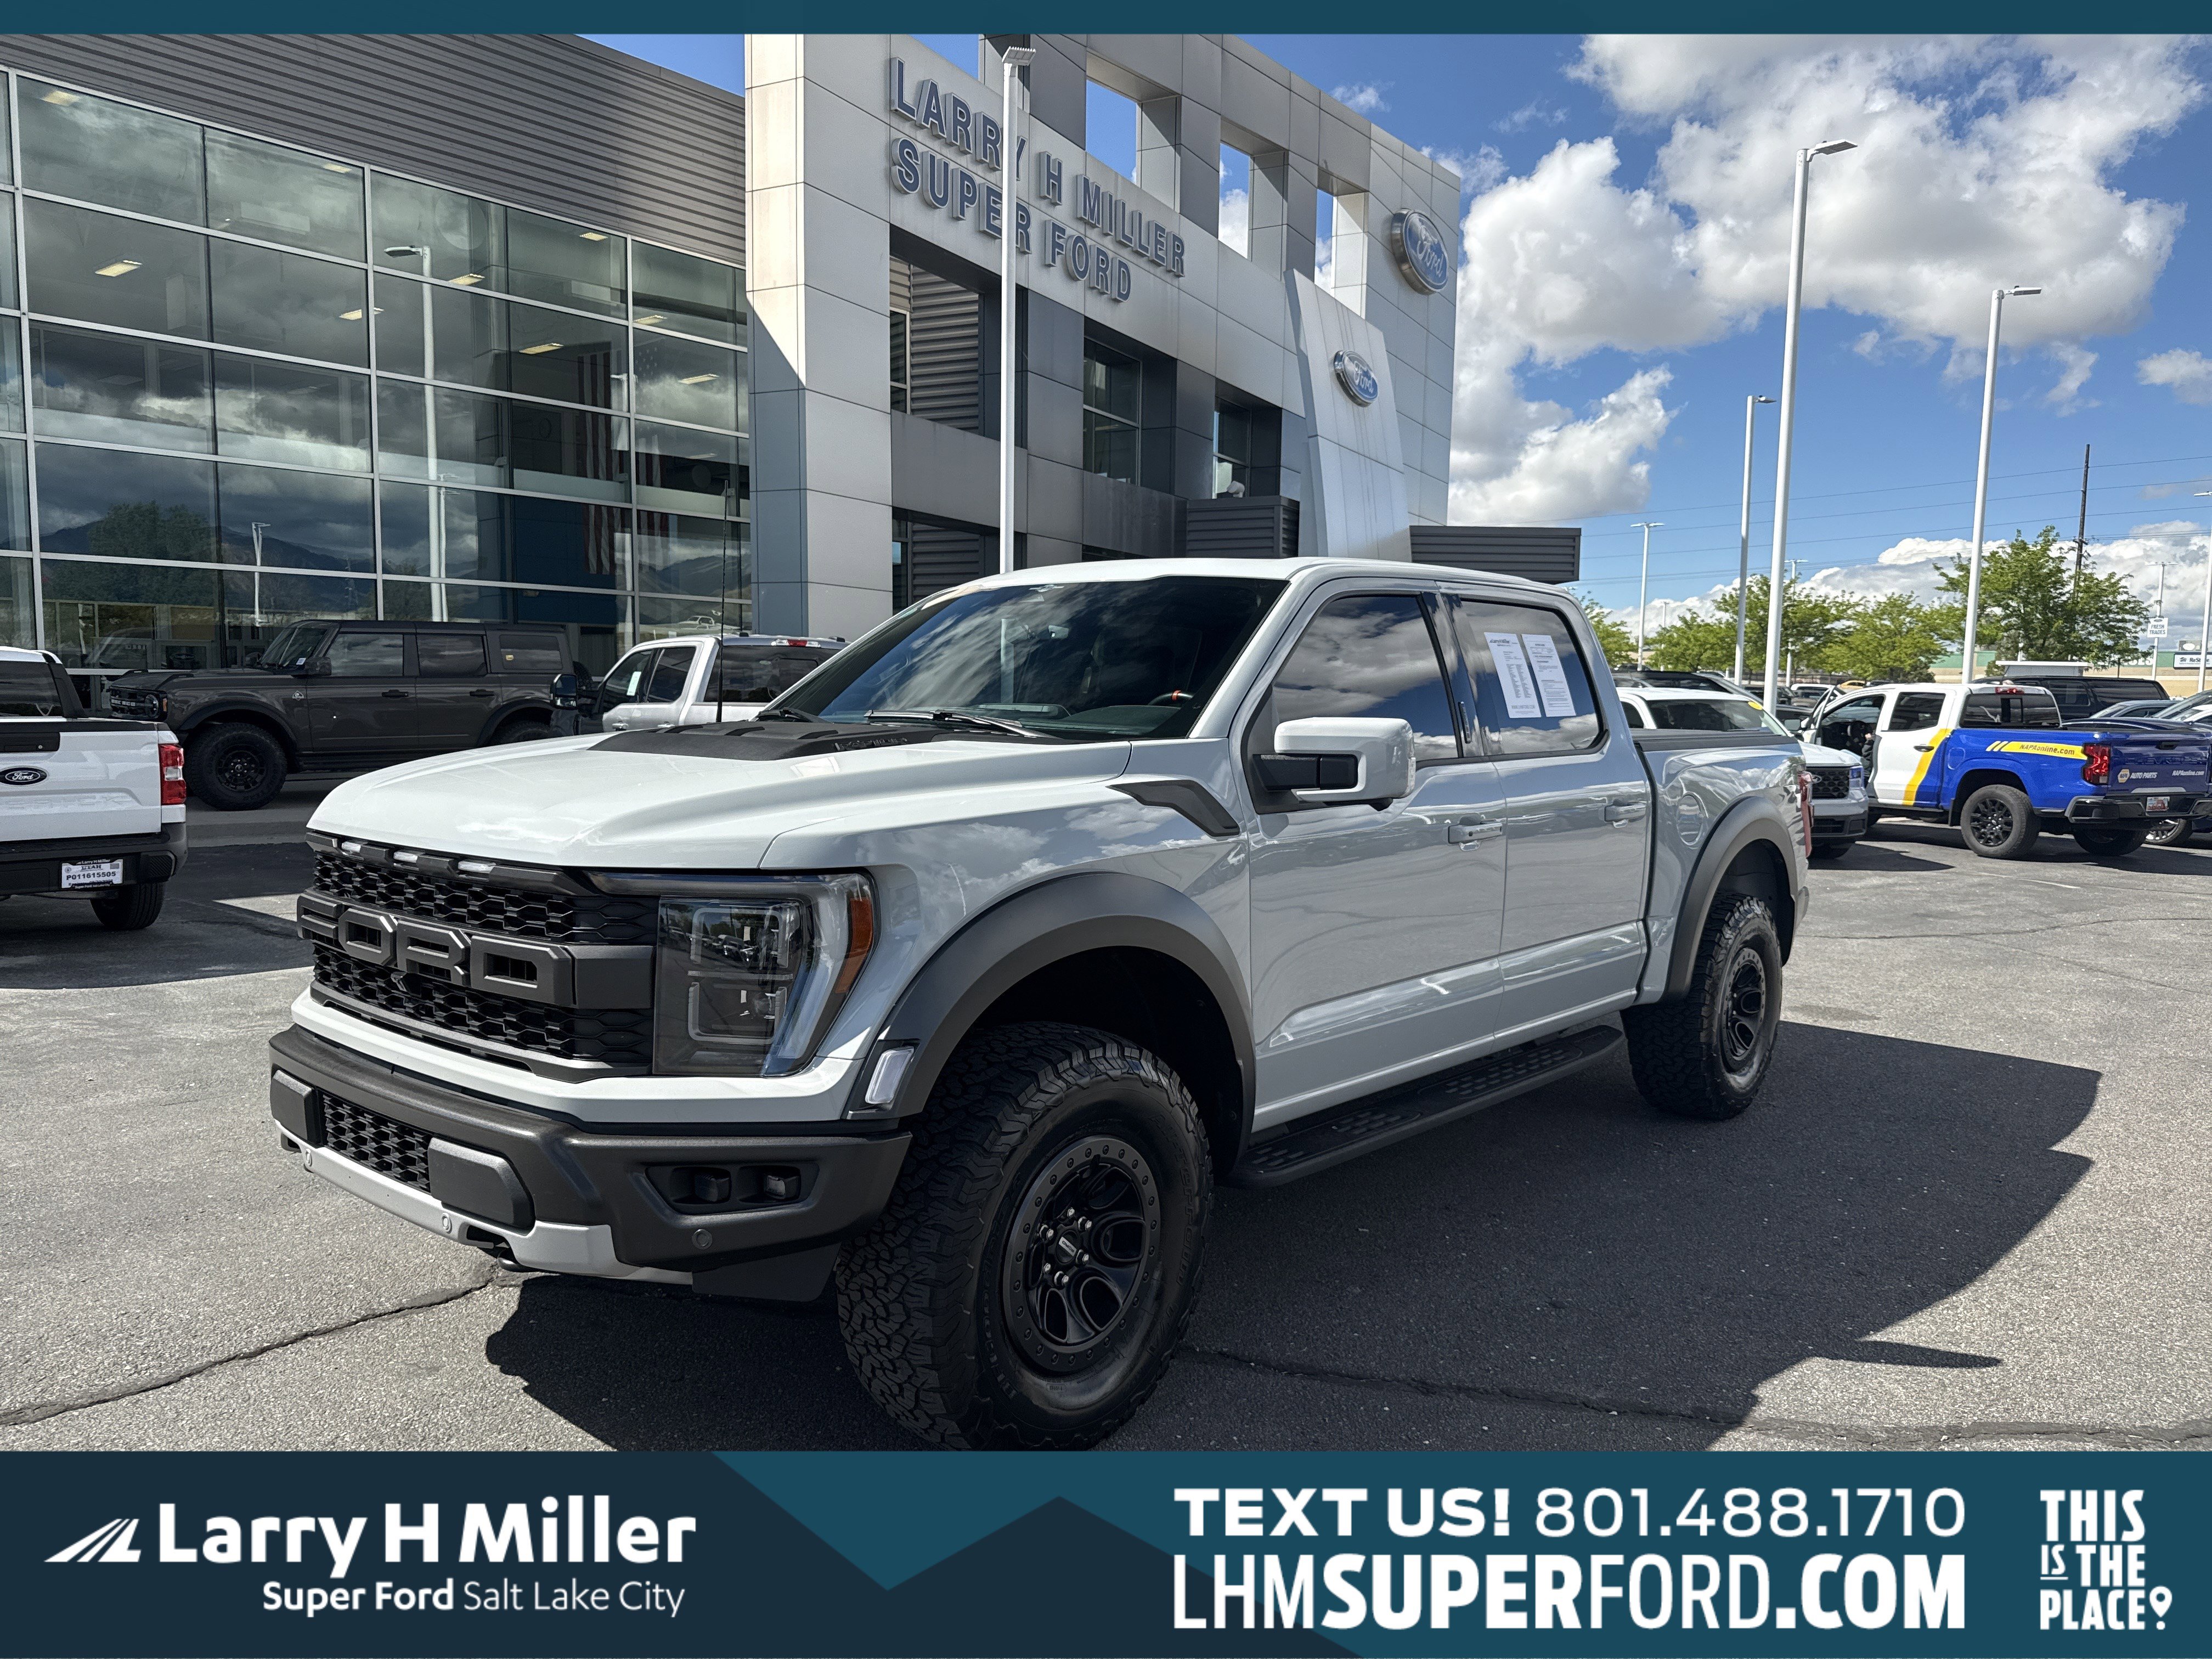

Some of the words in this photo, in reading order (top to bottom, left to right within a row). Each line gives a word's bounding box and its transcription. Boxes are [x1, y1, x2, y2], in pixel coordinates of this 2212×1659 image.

[890, 57, 1028, 180] LARRY
[1039, 150, 1063, 206] H
[1076, 174, 1185, 277] MILLER
[891, 137, 1032, 254] SUPER
[1045, 219, 1131, 302] FORD
[12, 772, 34, 781] Ford
[2019, 744, 2075, 755] NAPAonline.com
[66, 871, 116, 881] P011615505
[297, 886, 577, 1009] FORD
